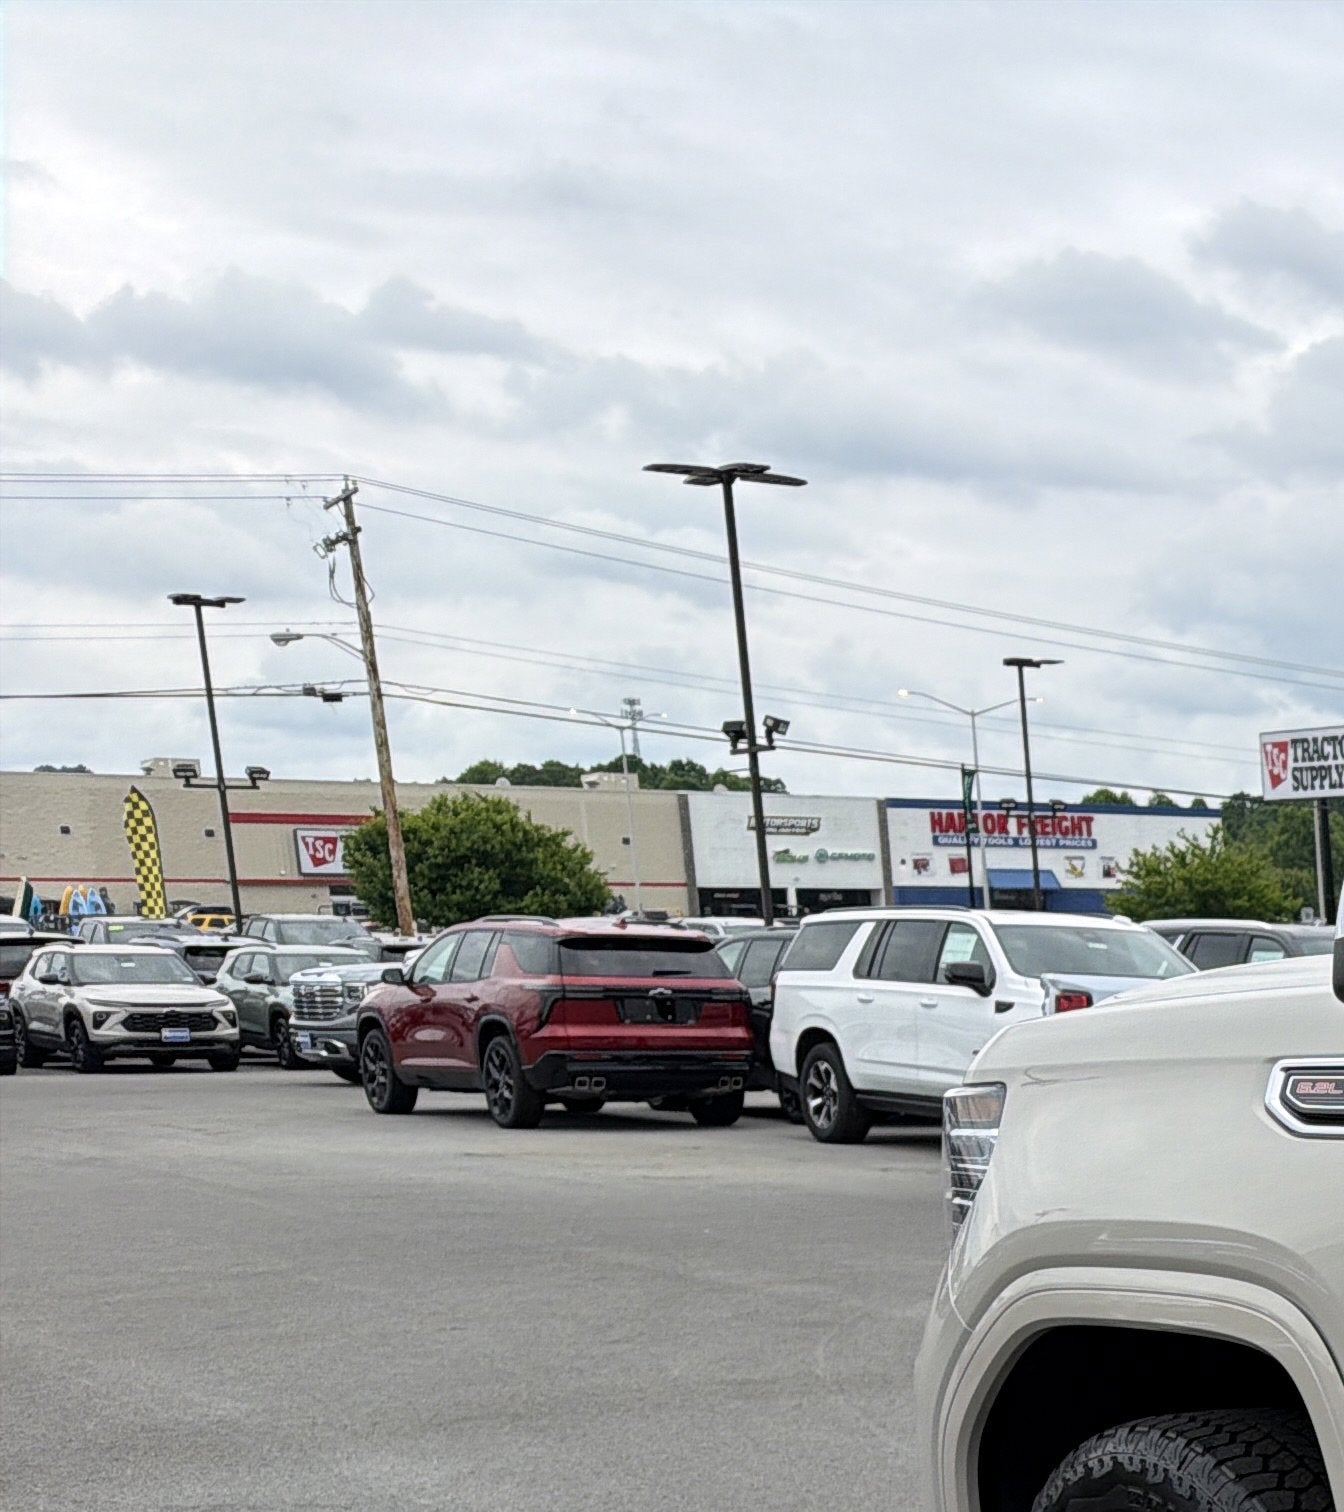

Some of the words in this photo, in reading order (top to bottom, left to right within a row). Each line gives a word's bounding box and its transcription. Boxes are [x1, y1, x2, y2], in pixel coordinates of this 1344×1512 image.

[1292, 763, 1344, 791] SUPPLY
[304, 836, 335, 862] TSC
[1296, 1081, 1344, 1095] 6.2L
